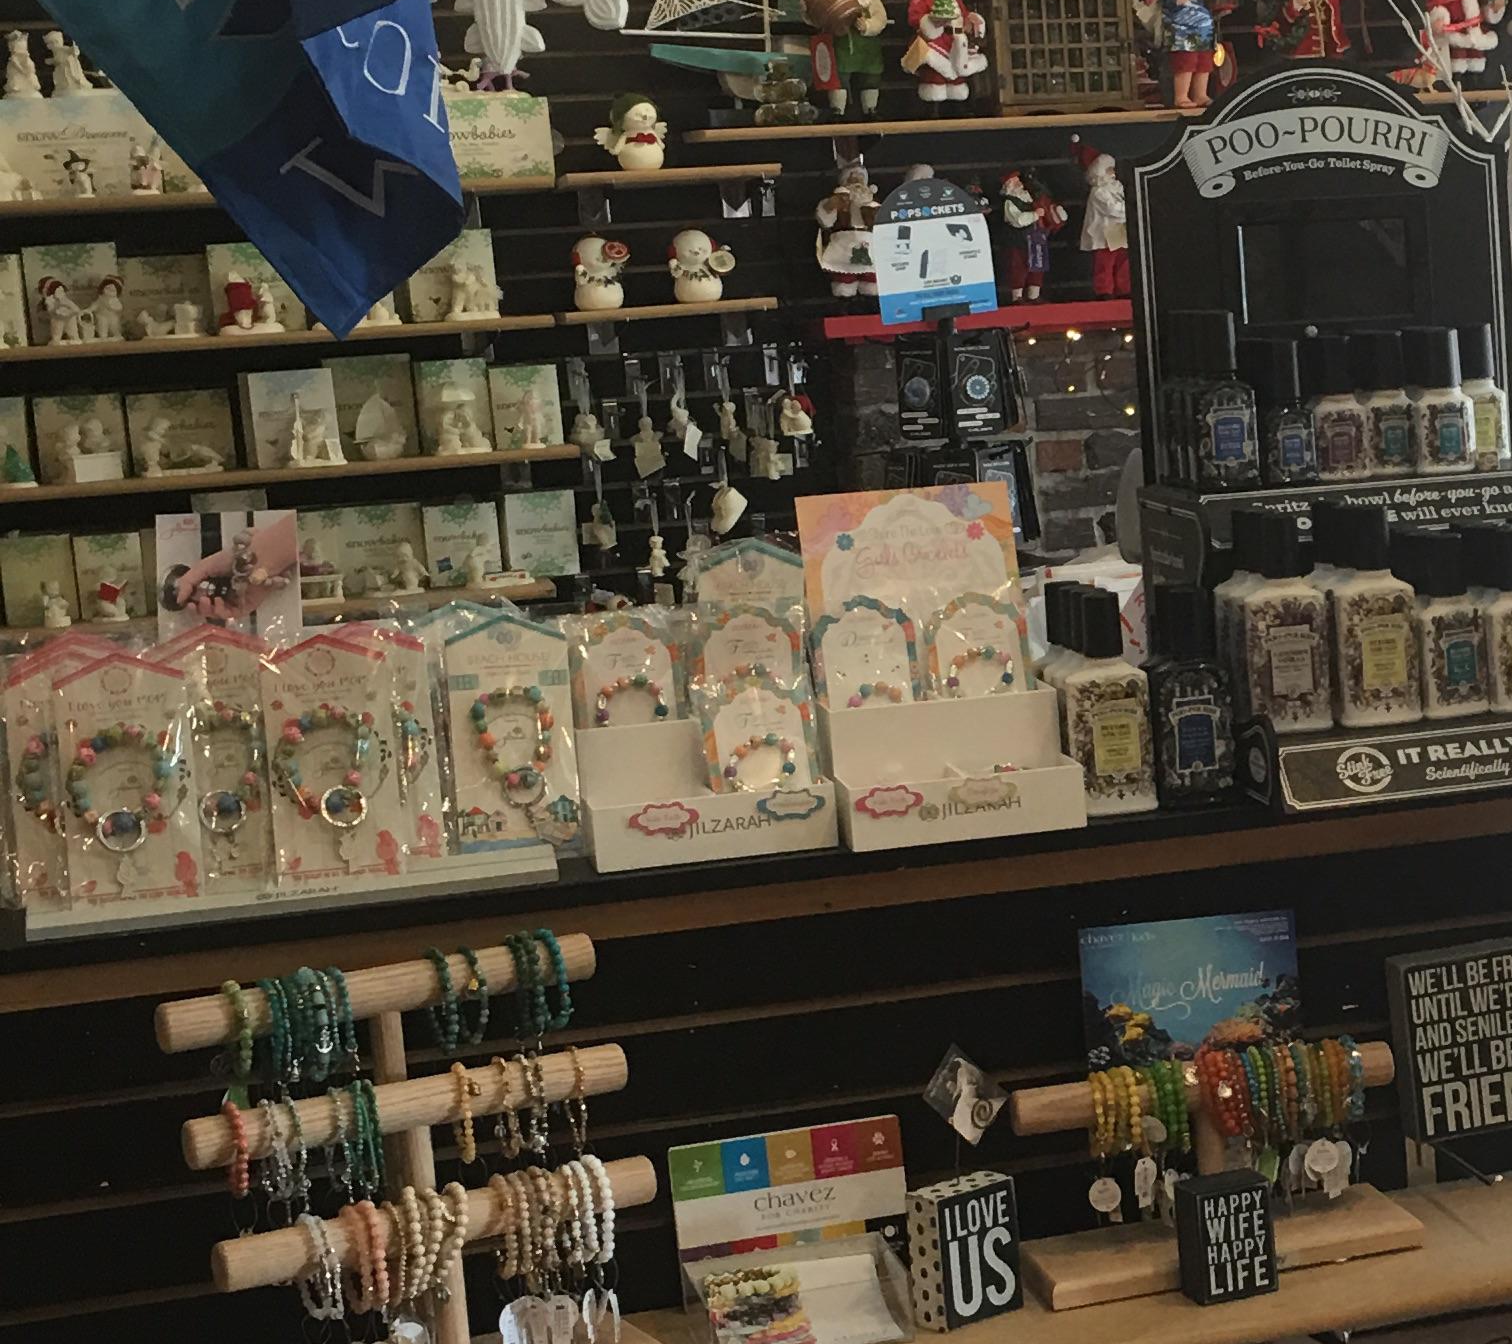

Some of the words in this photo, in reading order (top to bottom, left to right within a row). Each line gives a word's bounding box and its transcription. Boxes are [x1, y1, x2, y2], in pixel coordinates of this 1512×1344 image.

[1328, 158, 1361, 169] Toilet
[1362, 159, 1396, 176] Spray
[1400, 504, 1438, 521] will
[1441, 505, 1479, 519] ever
[1336, 754, 1373, 781] Stink
[1396, 748, 1422, 765] IT
[1425, 756, 1511, 781] Scientifically
[1361, 766, 1394, 785] Free
[1180, 961, 1265, 1004] Mermaid
[1408, 964, 1464, 996] WE'LL
[1465, 958, 1491, 986] BE
[1411, 991, 1467, 1024] UNTIL
[1415, 1022, 1452, 1051] AND
[1417, 1043, 1488, 1084] WE'LL
[754, 1184, 836, 1212] chavez
[1204, 1190, 1262, 1219] HAPPY
[944, 1207, 953, 1241] I
[955, 1189, 1011, 1235] LOVE
[1207, 1209, 1265, 1244] WIFE
[1207, 1235, 1265, 1265] HAPPY
[947, 1226, 1016, 1318] US
[1210, 1255, 1269, 1296] LIFE
